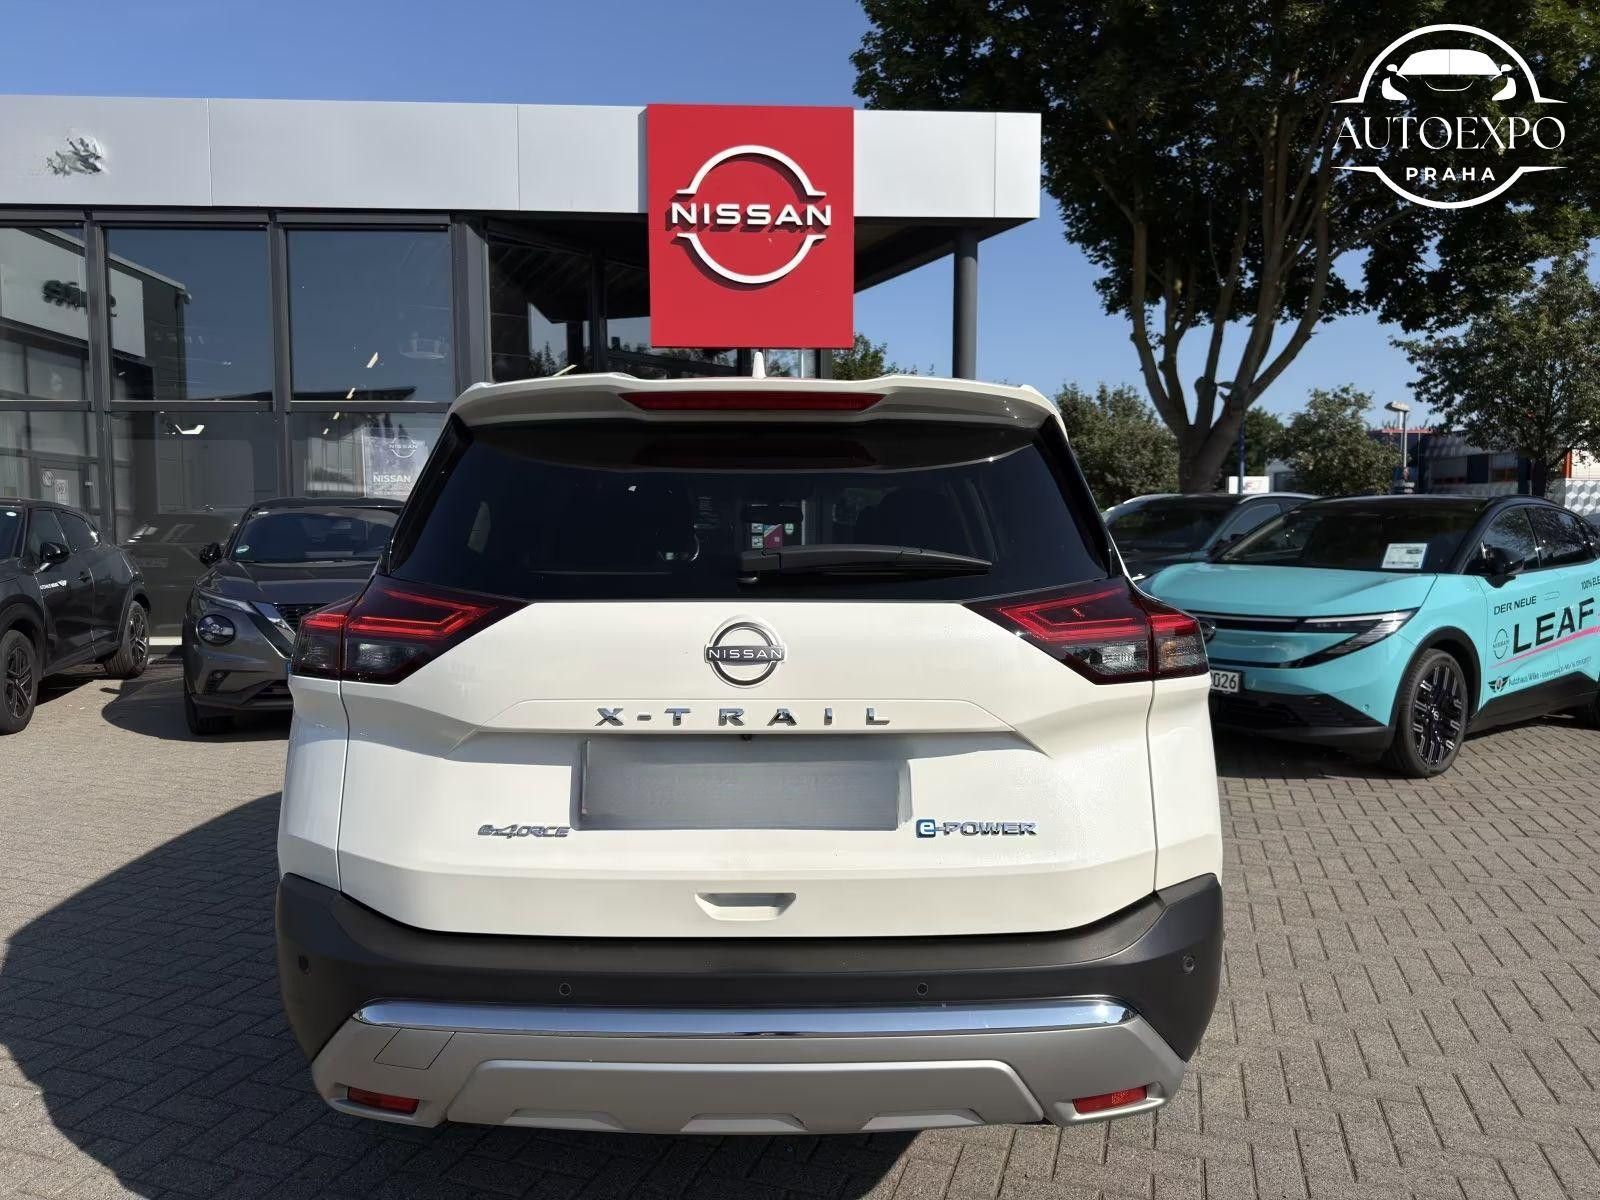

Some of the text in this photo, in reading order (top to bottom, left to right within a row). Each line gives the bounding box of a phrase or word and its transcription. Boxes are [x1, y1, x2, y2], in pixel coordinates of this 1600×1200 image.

[671, 202, 832, 226] NISSAN
[373, 474, 411, 483] NISSAN
[1493, 595, 1537, 615] DER NEUE
[1512, 597, 1595, 655] LEAF
[708, 648, 782, 659] NISSAN
[1211, 672, 1237, 690] 026
[594, 707, 890, 726] X-TRAIL
[916, 819, 1037, 838] e-POWER
